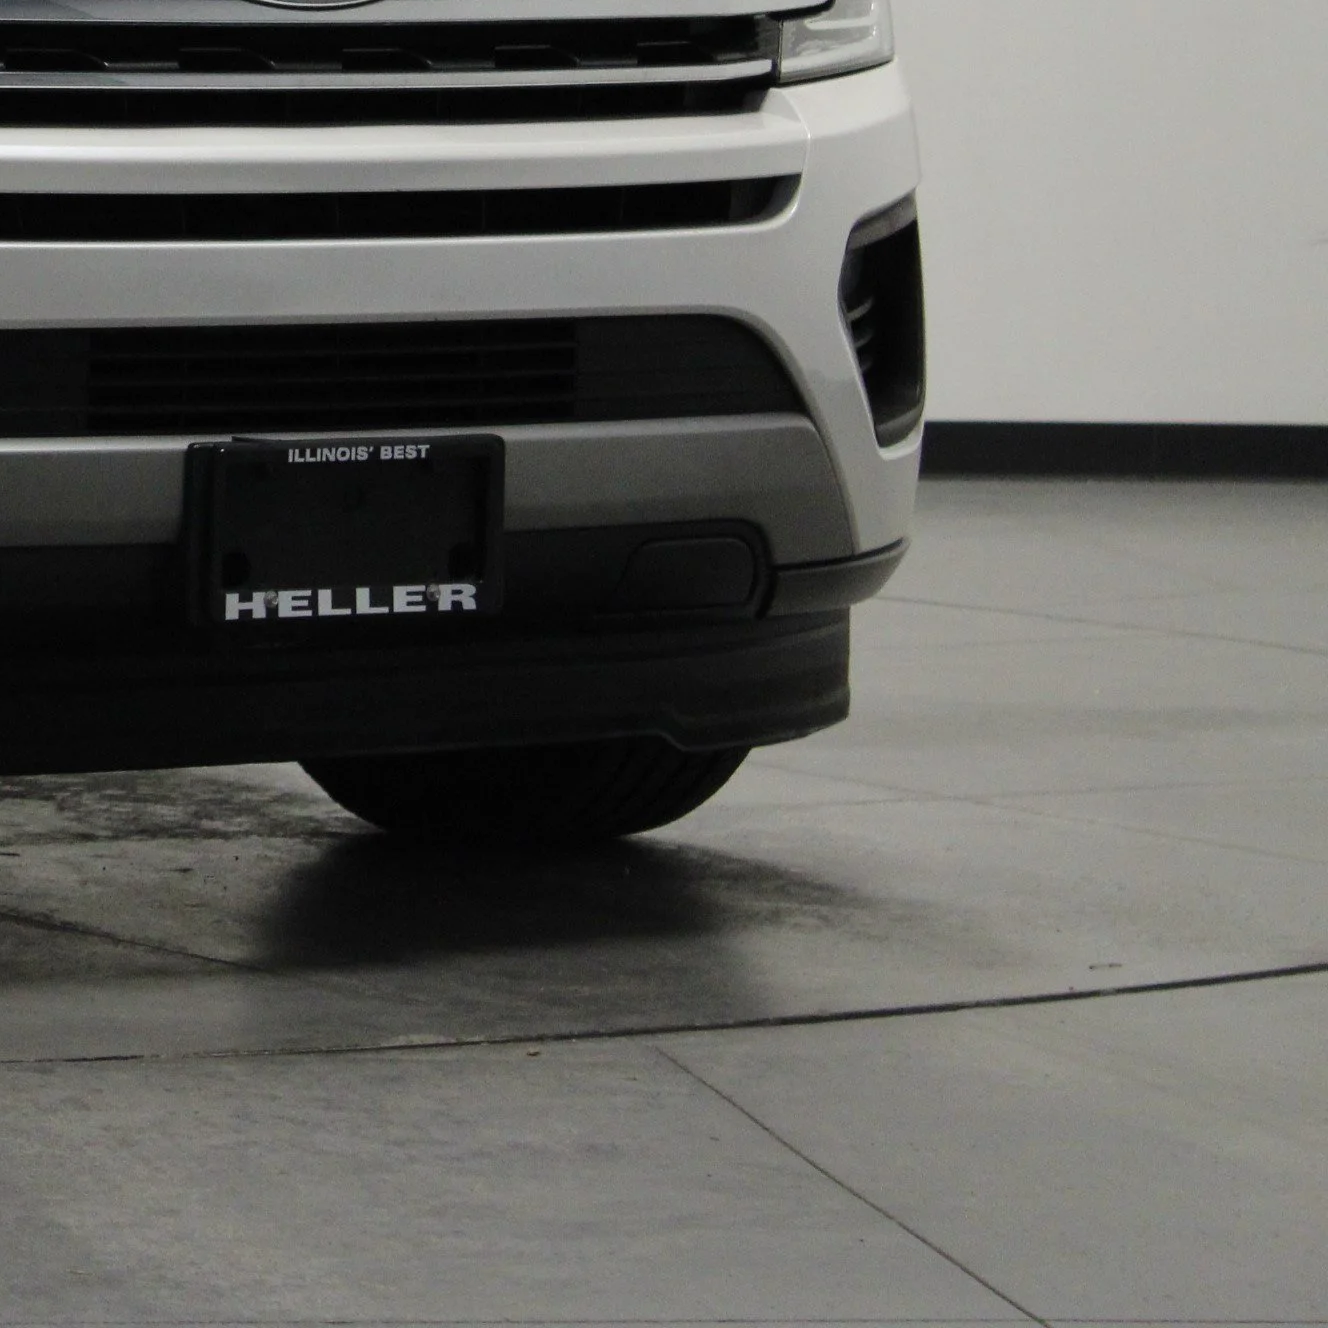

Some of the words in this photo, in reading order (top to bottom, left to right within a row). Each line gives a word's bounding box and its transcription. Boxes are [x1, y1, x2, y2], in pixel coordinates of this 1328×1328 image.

[287, 446, 375, 463] ILLINOIS'
[379, 444, 431, 460] BEST
[224, 583, 478, 621] HELLER
